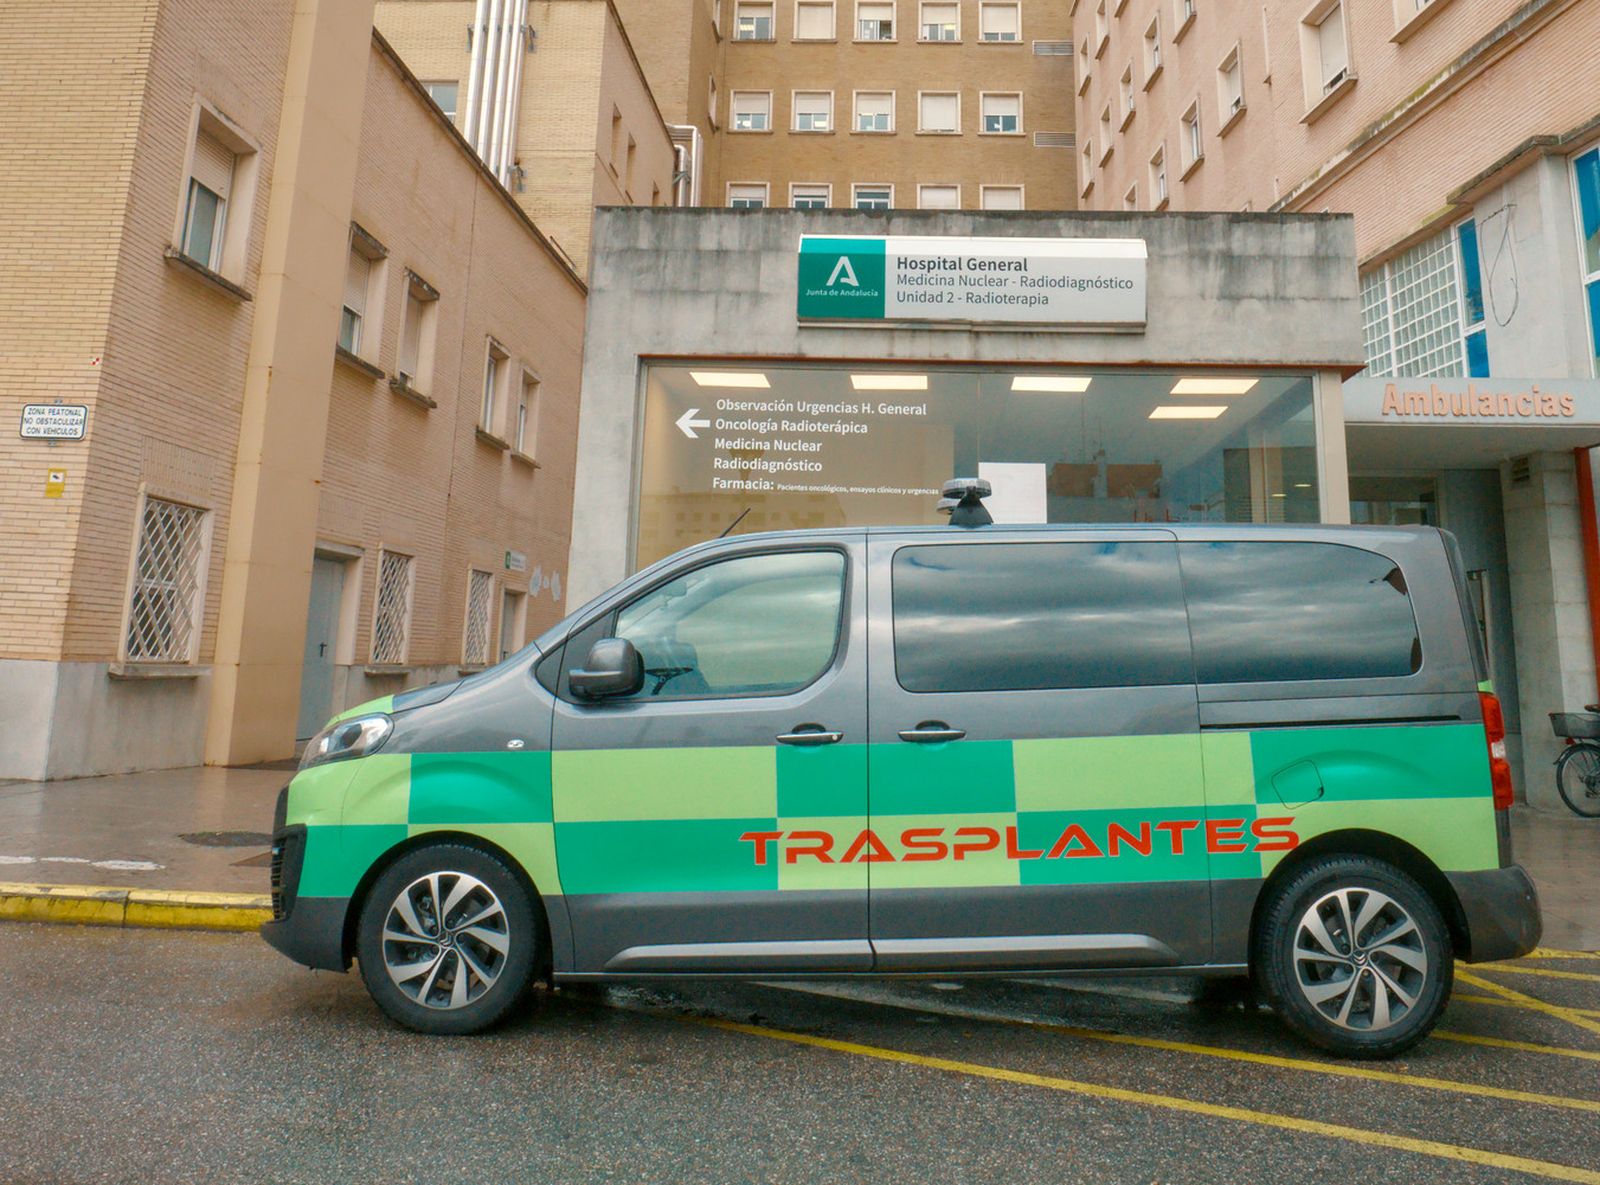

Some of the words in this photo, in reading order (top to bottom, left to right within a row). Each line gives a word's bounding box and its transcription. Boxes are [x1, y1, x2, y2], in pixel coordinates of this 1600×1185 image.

[897, 256, 963, 273] Hospital
[966, 257, 1028, 272] General
[897, 274, 955, 286] Medicina
[958, 275, 1009, 288] Nuclear
[1020, 275, 1134, 292] Radiodiagnóstico
[806, 288, 828, 296] Junta
[828, 288, 839, 296] de
[897, 291, 944, 304] Unidad
[946, 292, 955, 304] 2
[966, 292, 1049, 307] Radioterapia
[716, 398, 794, 412] Observación
[797, 401, 859, 415] Urgencias
[861, 403, 875, 414] H.
[878, 403, 927, 416] General
[1381, 383, 1576, 417] Ambulancias
[24, 417, 33, 425] NO
[48, 408, 82, 417] PEATONAL
[715, 418, 778, 434] Oncología
[781, 419, 868, 435] Radioterápica
[714, 438, 771, 451] Medicina
[774, 439, 822, 452] Nuclear
[713, 457, 823, 474] Radiodiagnóstico
[712, 477, 774, 490] Farmacia:
[777, 483, 808, 492] Pacientes
[849, 486, 876, 494] ensayos
[907, 487, 939, 496] urgencias
[738, 816, 1300, 866] TRASPLANTES
